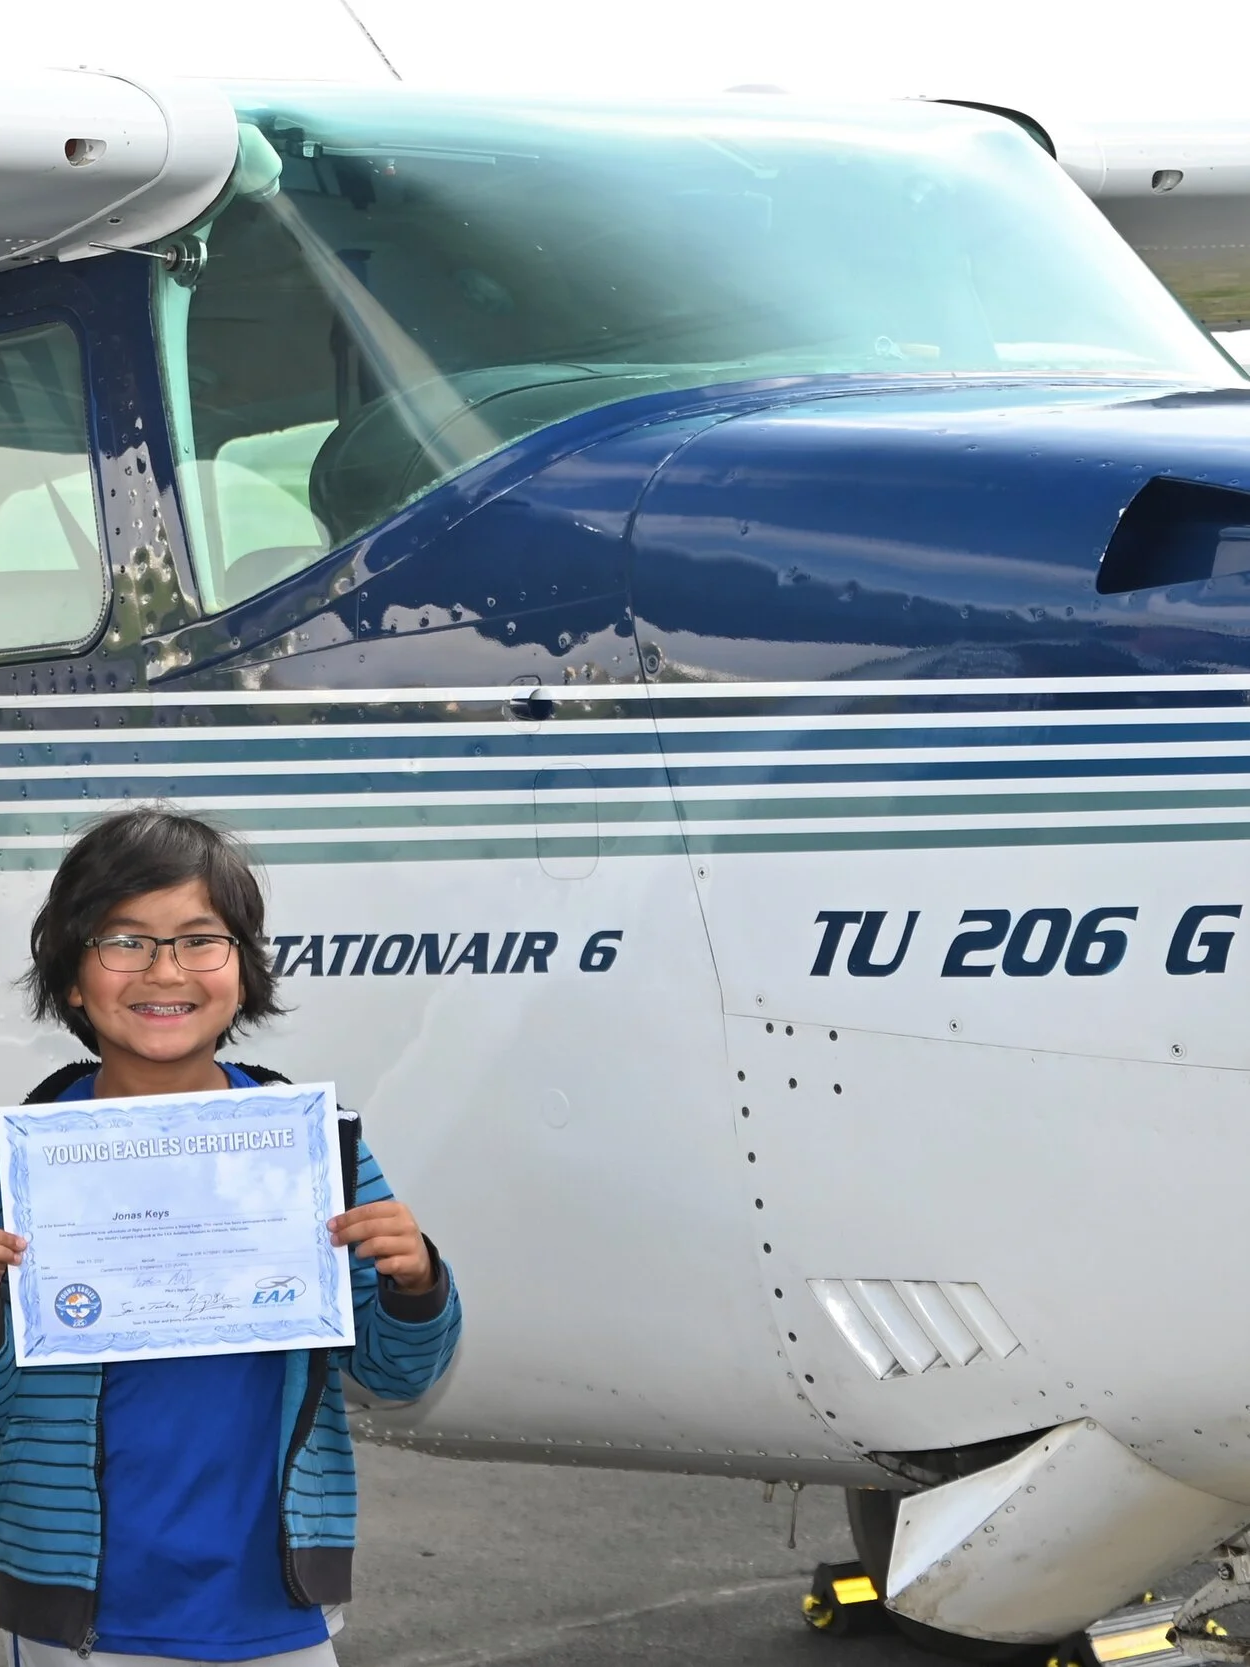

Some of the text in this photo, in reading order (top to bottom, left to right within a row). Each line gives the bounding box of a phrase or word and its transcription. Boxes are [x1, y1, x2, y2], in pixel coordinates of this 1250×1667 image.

[262, 929, 623, 977] TATIONAIR 6
[810, 904, 1242, 978] TU 206 G
[43, 1128, 295, 1165] YOUNG EAGLES CERTIFICATE
[112, 1209, 170, 1221] Jonas Keys
[251, 1288, 296, 1305] EAA
